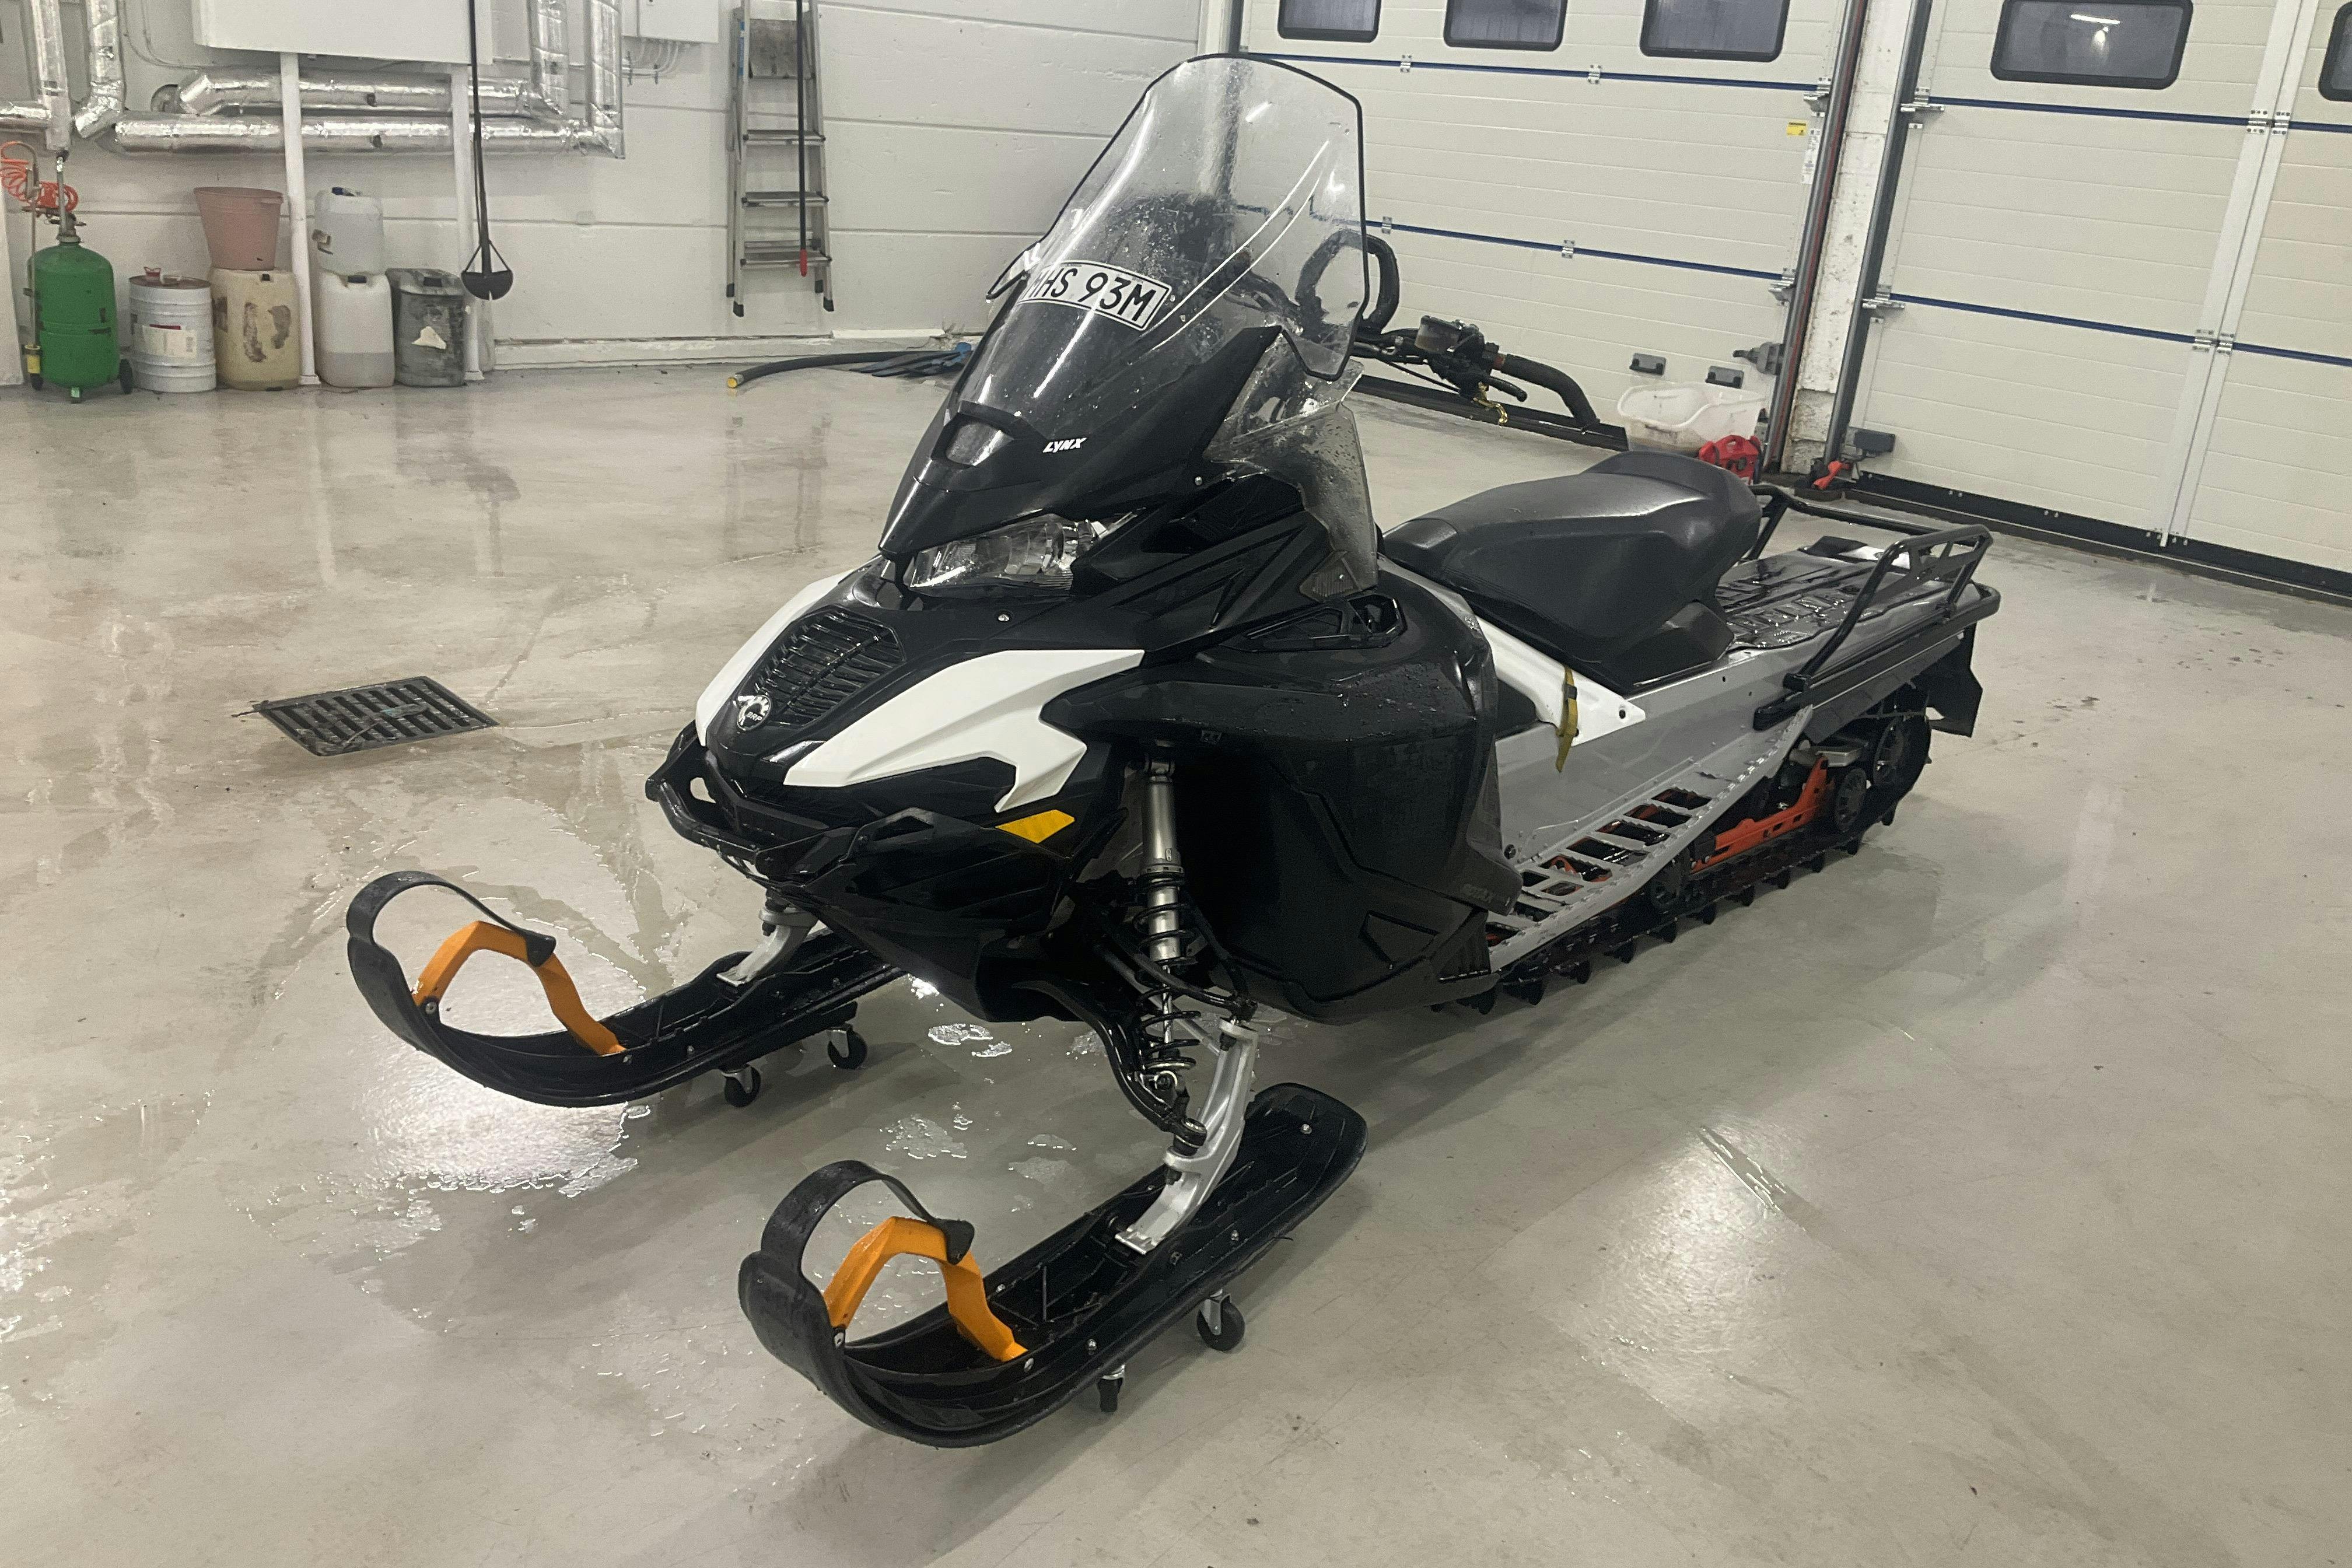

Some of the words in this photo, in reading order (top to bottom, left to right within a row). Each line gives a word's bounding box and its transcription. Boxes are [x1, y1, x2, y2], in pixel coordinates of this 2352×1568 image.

[1077, 272, 1157, 321] 93M
[1042, 438, 1087, 453] LYNX
[746, 711, 763, 721] BRP
